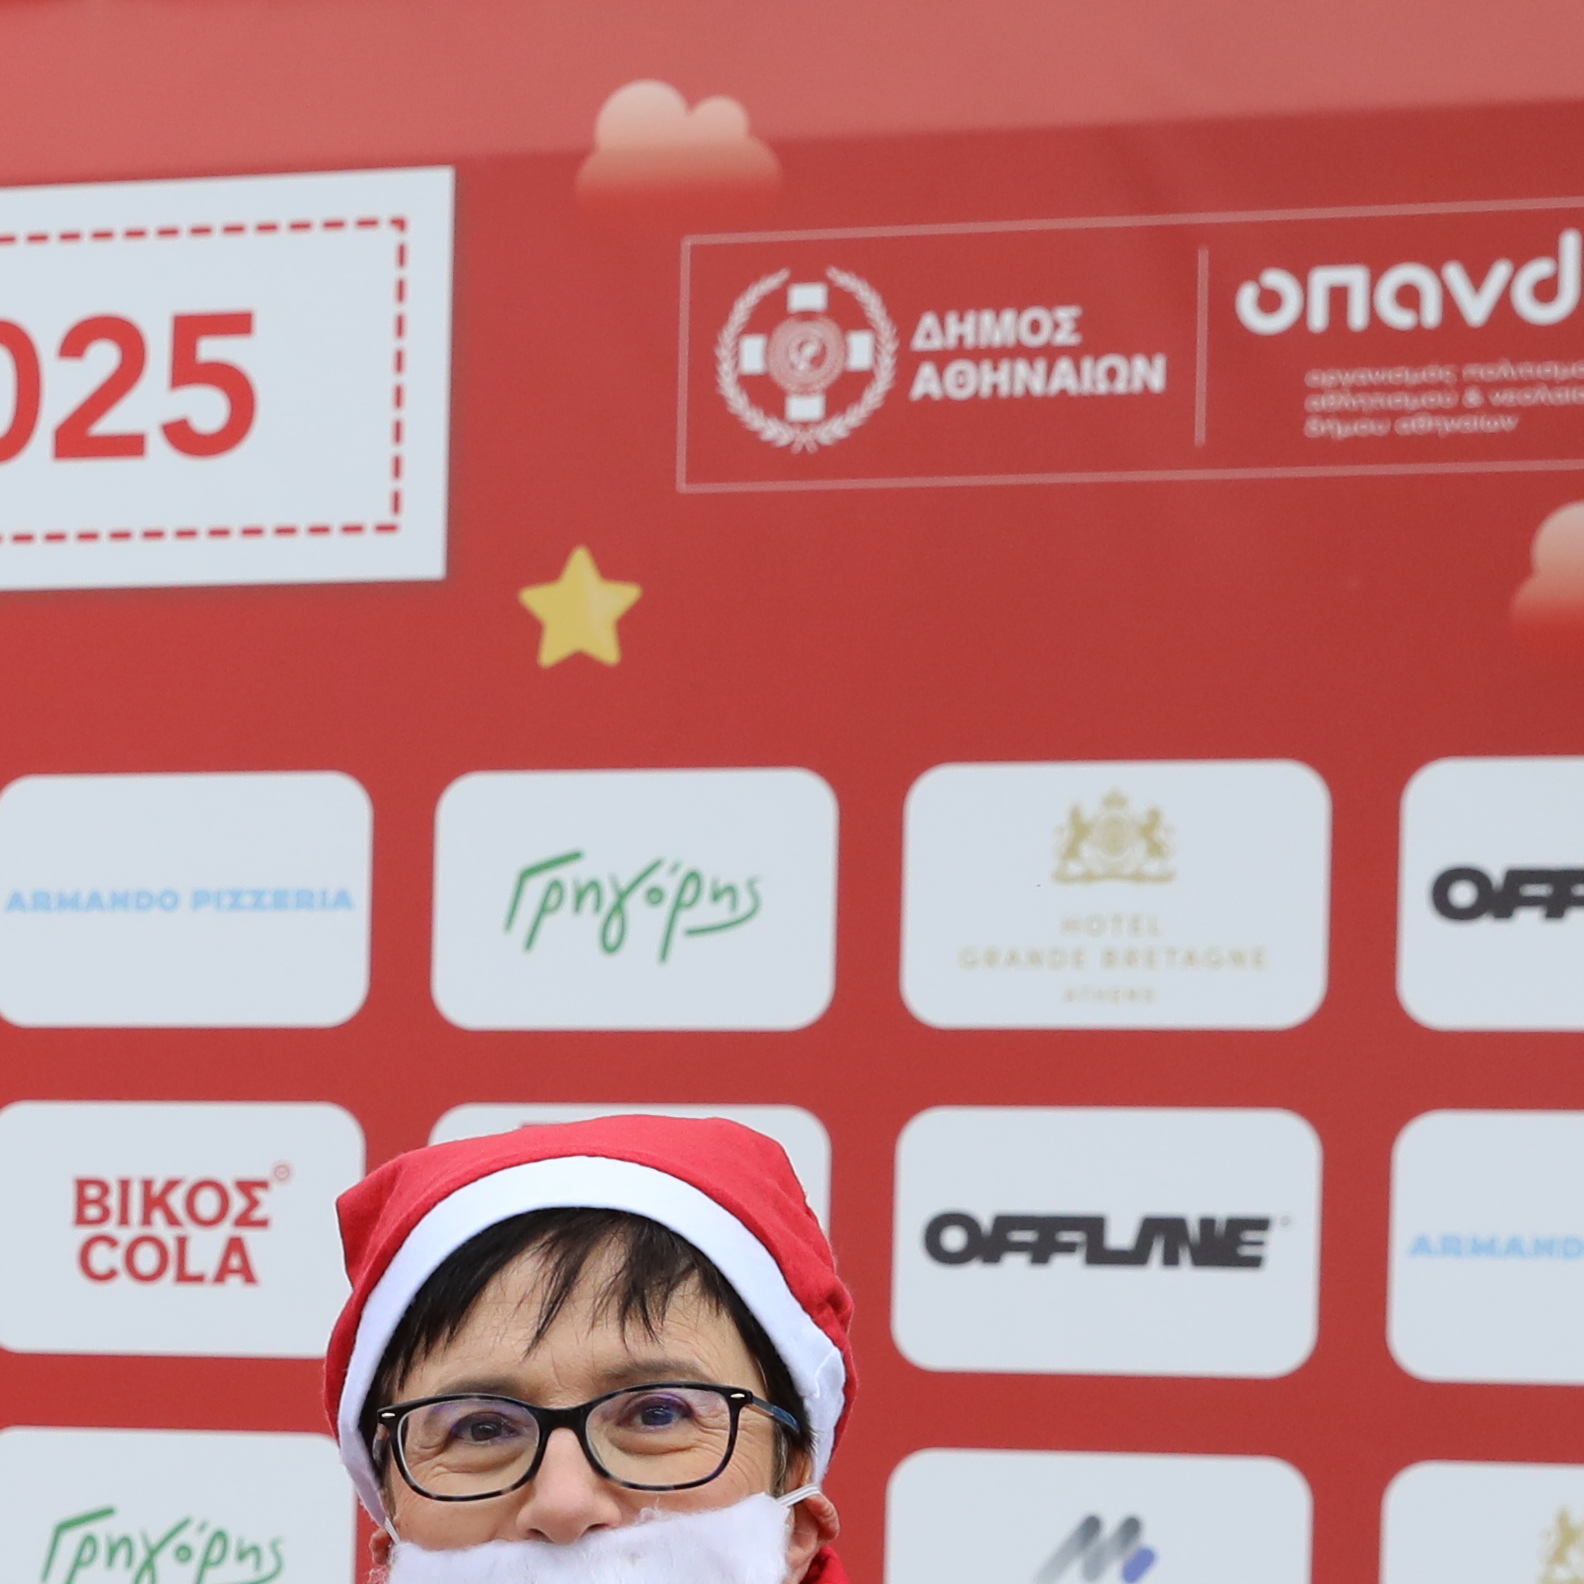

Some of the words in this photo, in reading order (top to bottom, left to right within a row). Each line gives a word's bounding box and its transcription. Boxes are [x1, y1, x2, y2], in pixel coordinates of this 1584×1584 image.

[911, 304, 1083, 352] ΔΗΜΟΣ
[908, 353, 1168, 401] ΑΘΗΝΑΙΩΝ
[5, 890, 180, 914] ARMANDO
[191, 888, 354, 913] PIZZERIA
[503, 849, 763, 964] Γρηγόρης
[1060, 913, 1163, 937] HOTEL
[958, 946, 1085, 970] GRANDE
[73, 1177, 270, 1227] ΒΙΚΟΣ
[78, 1234, 258, 1285] COLA
[1409, 1232, 1584, 1261] ARMAND
